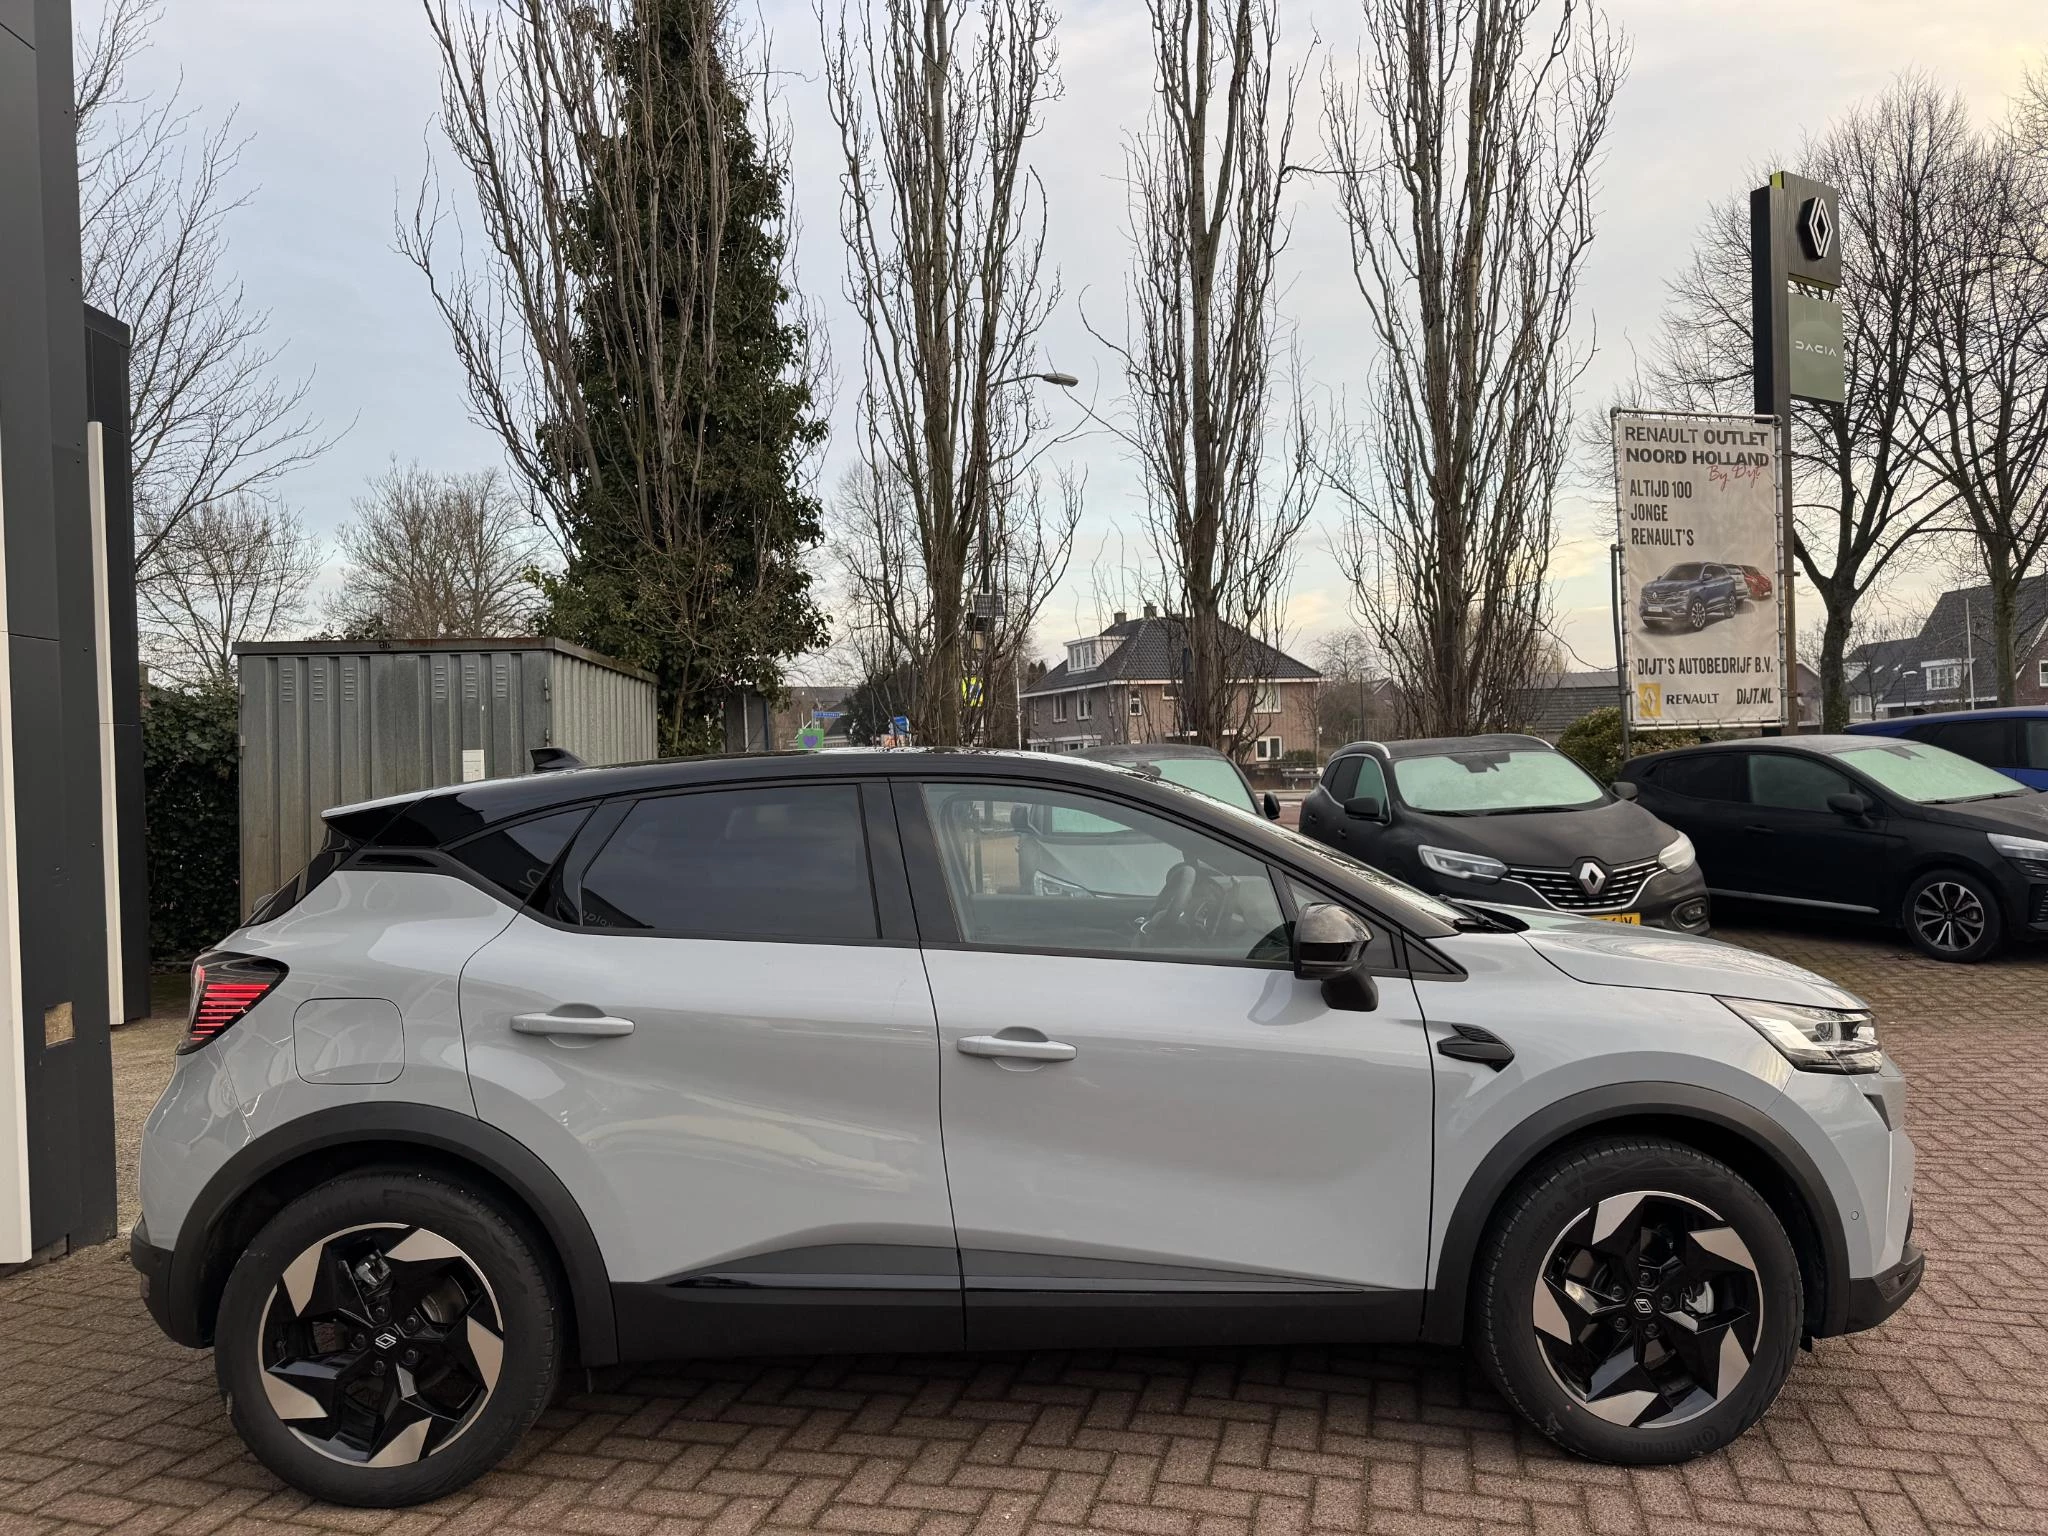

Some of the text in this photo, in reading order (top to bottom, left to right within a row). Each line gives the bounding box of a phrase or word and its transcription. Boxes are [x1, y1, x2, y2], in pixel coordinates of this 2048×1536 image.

[1795, 340, 1837, 358] DACIA
[1625, 426, 1768, 446] RENAULT OUTLET
[1626, 448, 1769, 467] NOORD HOLLAND
[1707, 465, 1730, 491] By
[1630, 479, 1692, 498] ALTIJD 100
[1630, 504, 1668, 522] JONGE
[1631, 528, 1695, 546] RENAULT'S
[1637, 656, 1774, 675] DIJT'S AUTOBEDRIJF B.V.
[1666, 687, 1774, 705] RENAULT DIJT.NL
